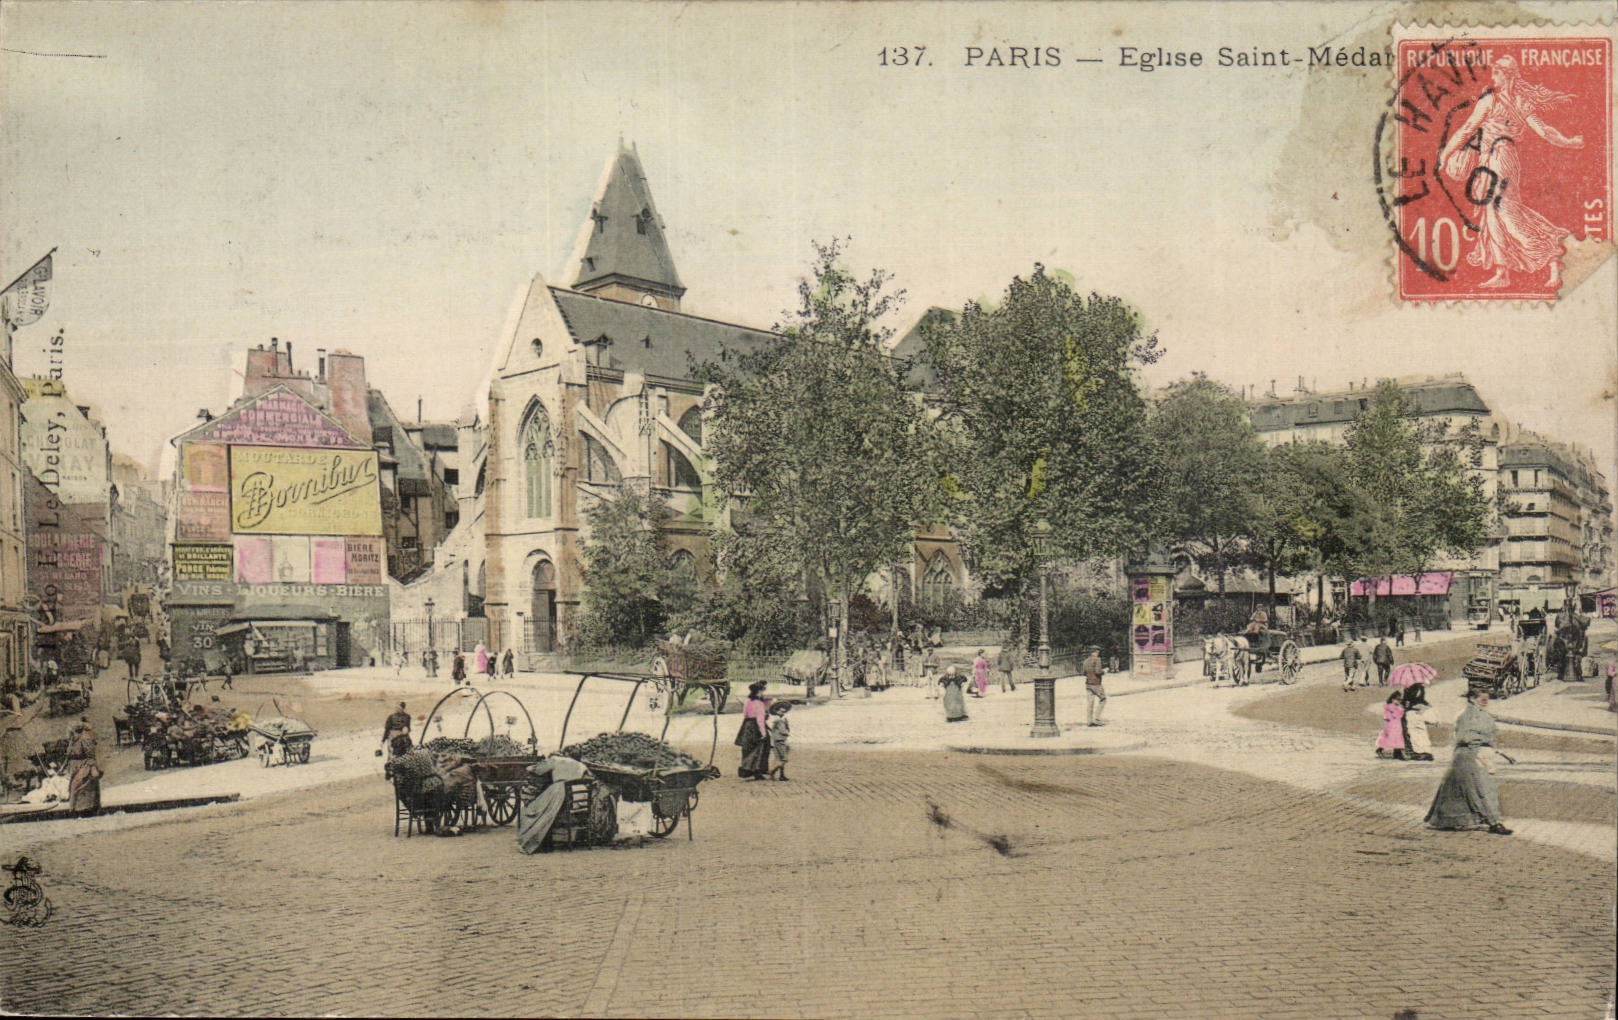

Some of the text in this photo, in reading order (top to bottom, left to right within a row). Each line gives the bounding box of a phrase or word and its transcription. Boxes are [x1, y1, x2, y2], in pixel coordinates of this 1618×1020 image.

[1521, 49, 1603, 69] FRANÇAISE
[27, 435, 97, 449] CHOLAT
[237, 455, 377, 529] Bornibus
[175, 583, 223, 596] VINS
[237, 583, 328, 597] LIQUEURS
